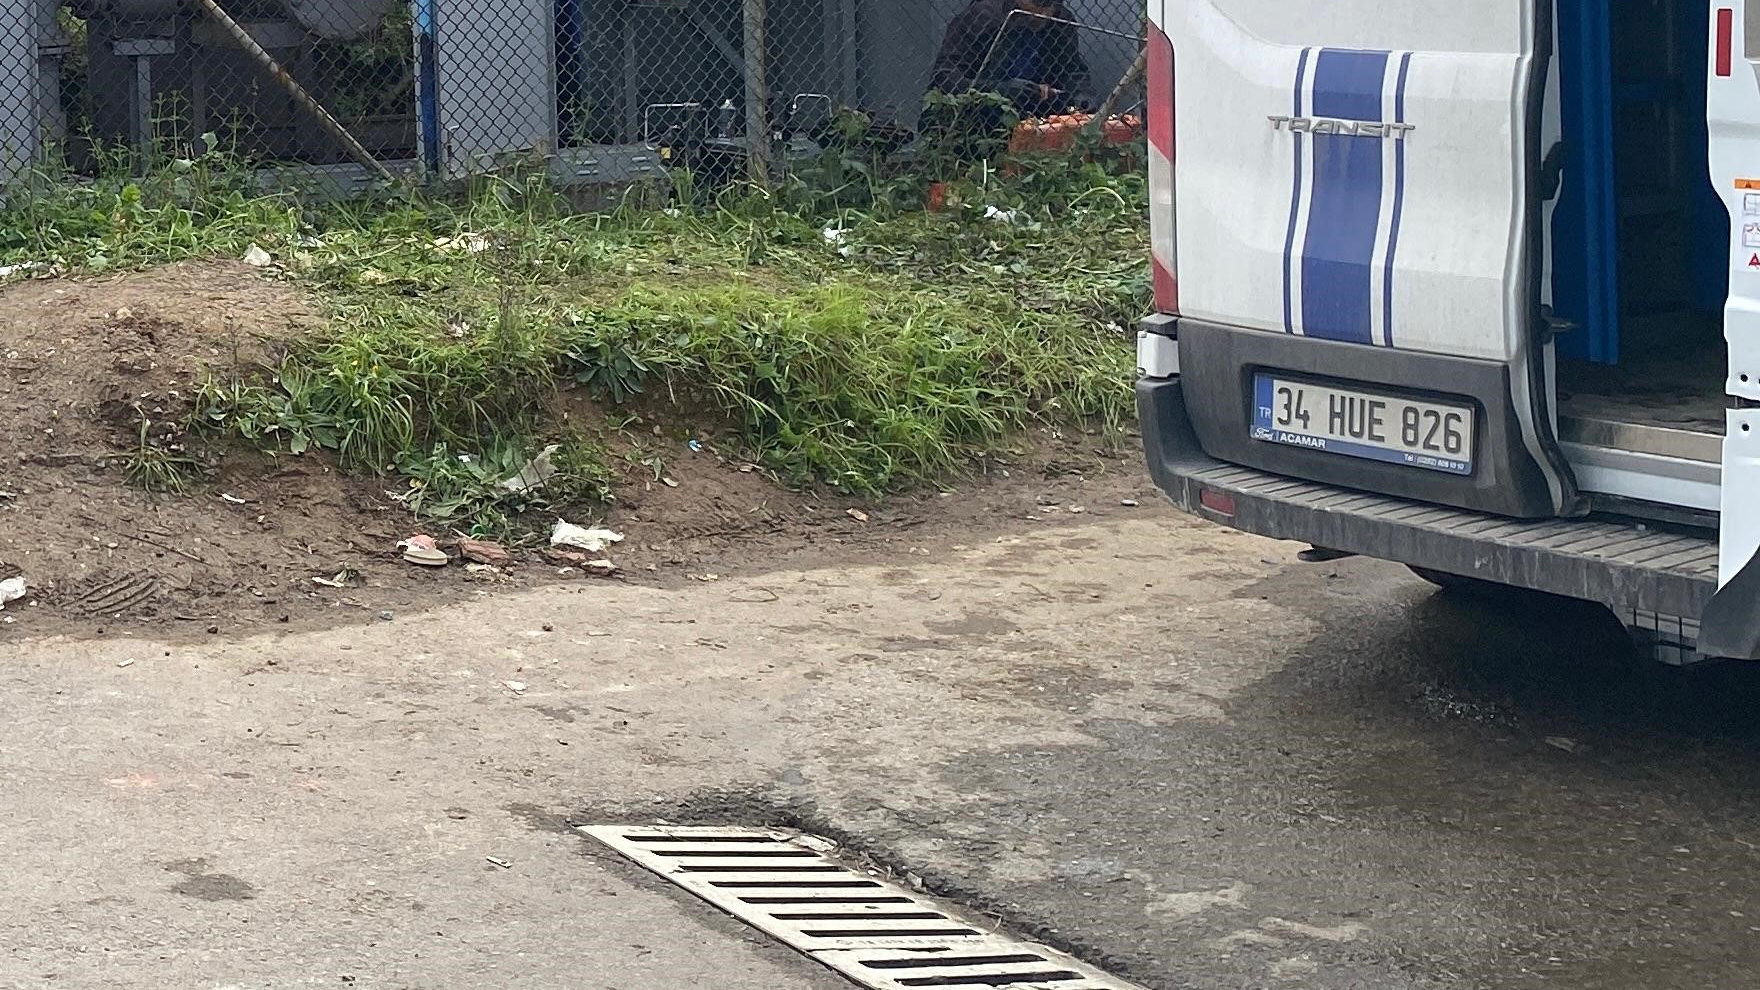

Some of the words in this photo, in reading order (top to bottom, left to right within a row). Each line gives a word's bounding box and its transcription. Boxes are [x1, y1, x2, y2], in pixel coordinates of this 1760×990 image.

[1267, 115, 1416, 140] TRANSIT
[1259, 406, 1272, 418] TR
[1277, 387, 1310, 430] 34
[1329, 394, 1386, 443] HUE
[1402, 405, 1462, 454] 826
[1280, 432, 1326, 449] ACAMAR
